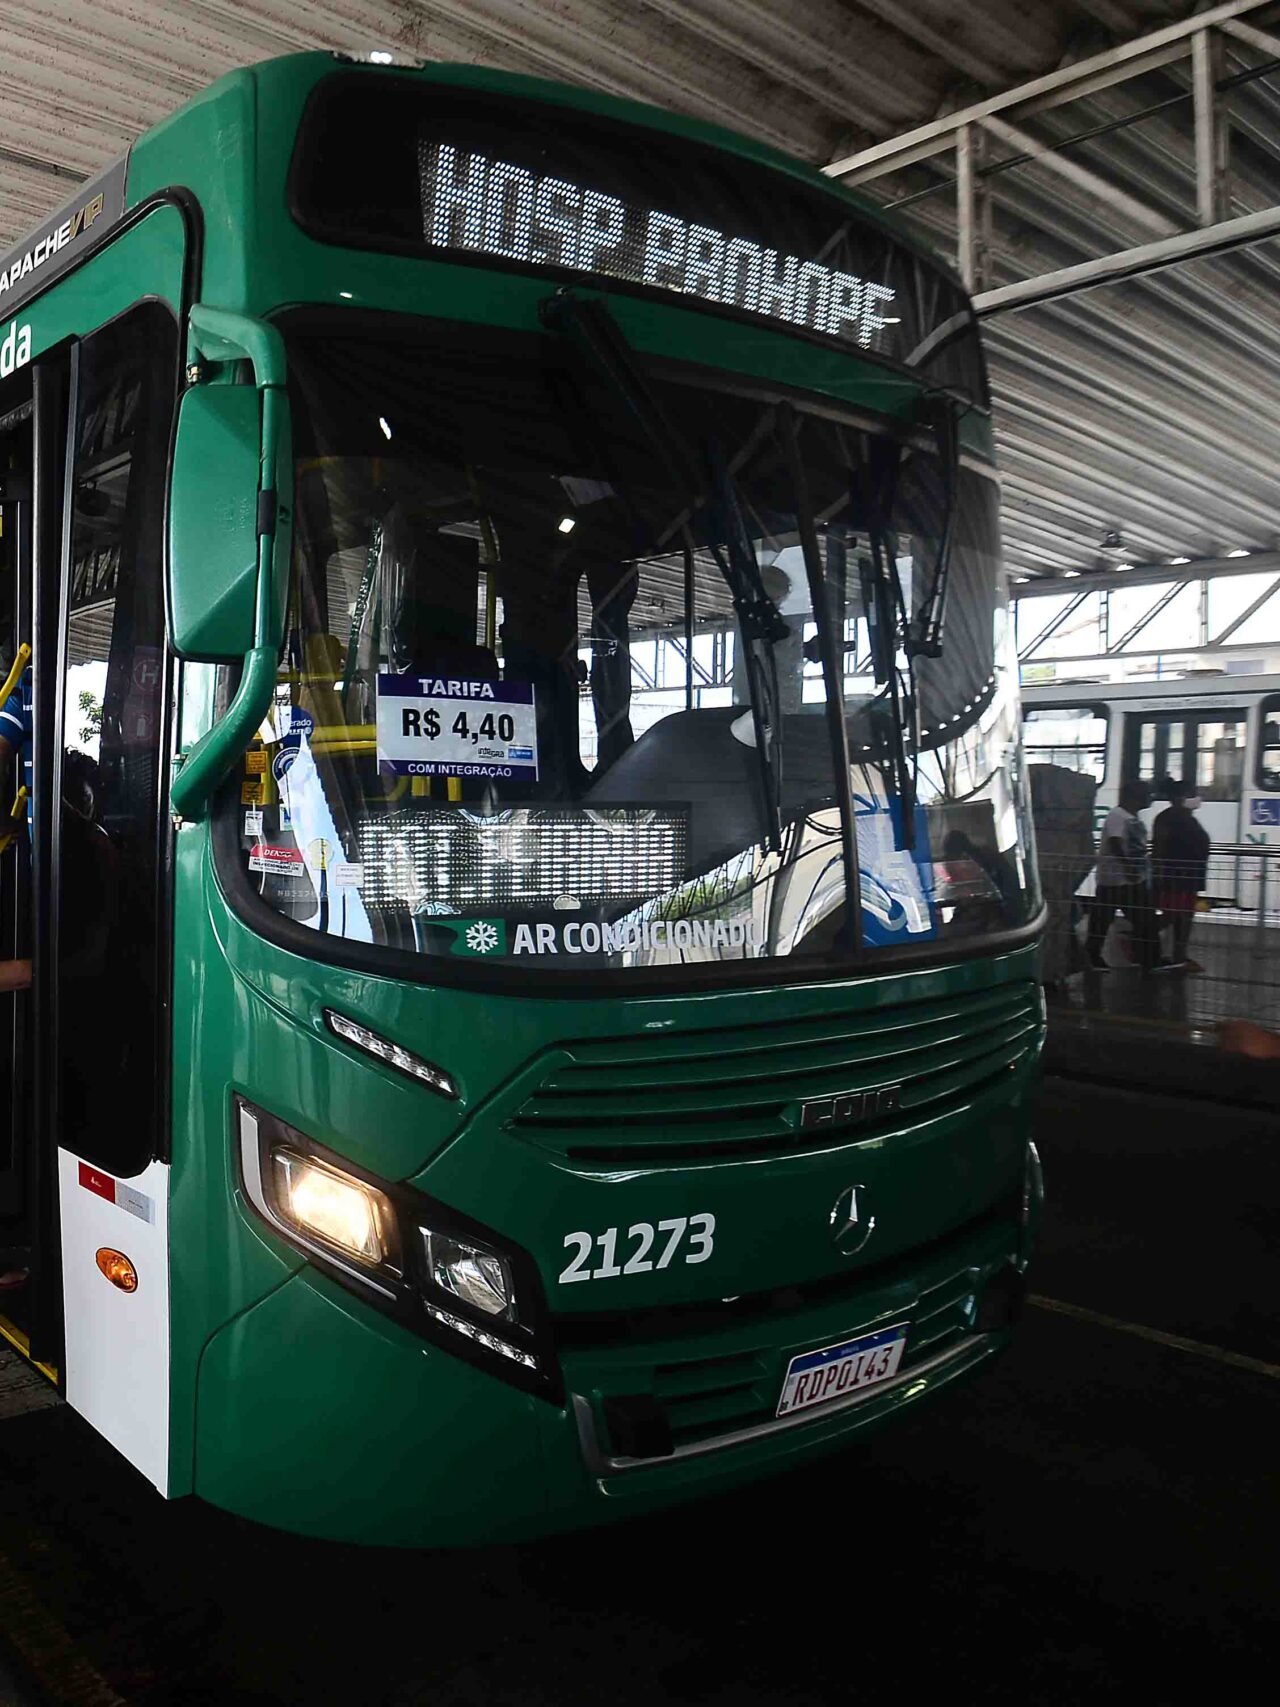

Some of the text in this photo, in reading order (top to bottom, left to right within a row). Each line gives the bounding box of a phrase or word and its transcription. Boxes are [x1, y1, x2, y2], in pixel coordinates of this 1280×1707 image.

[432, 144, 625, 271] HOSP
[418, 678, 495, 698] TARIFA
[402, 708, 514, 745] R$ 4,40
[408, 763, 512, 778] COM INTEGRAÇÃO
[513, 917, 761, 955] AR CONDICIONADO
[558, 1213, 716, 1284] 21273
